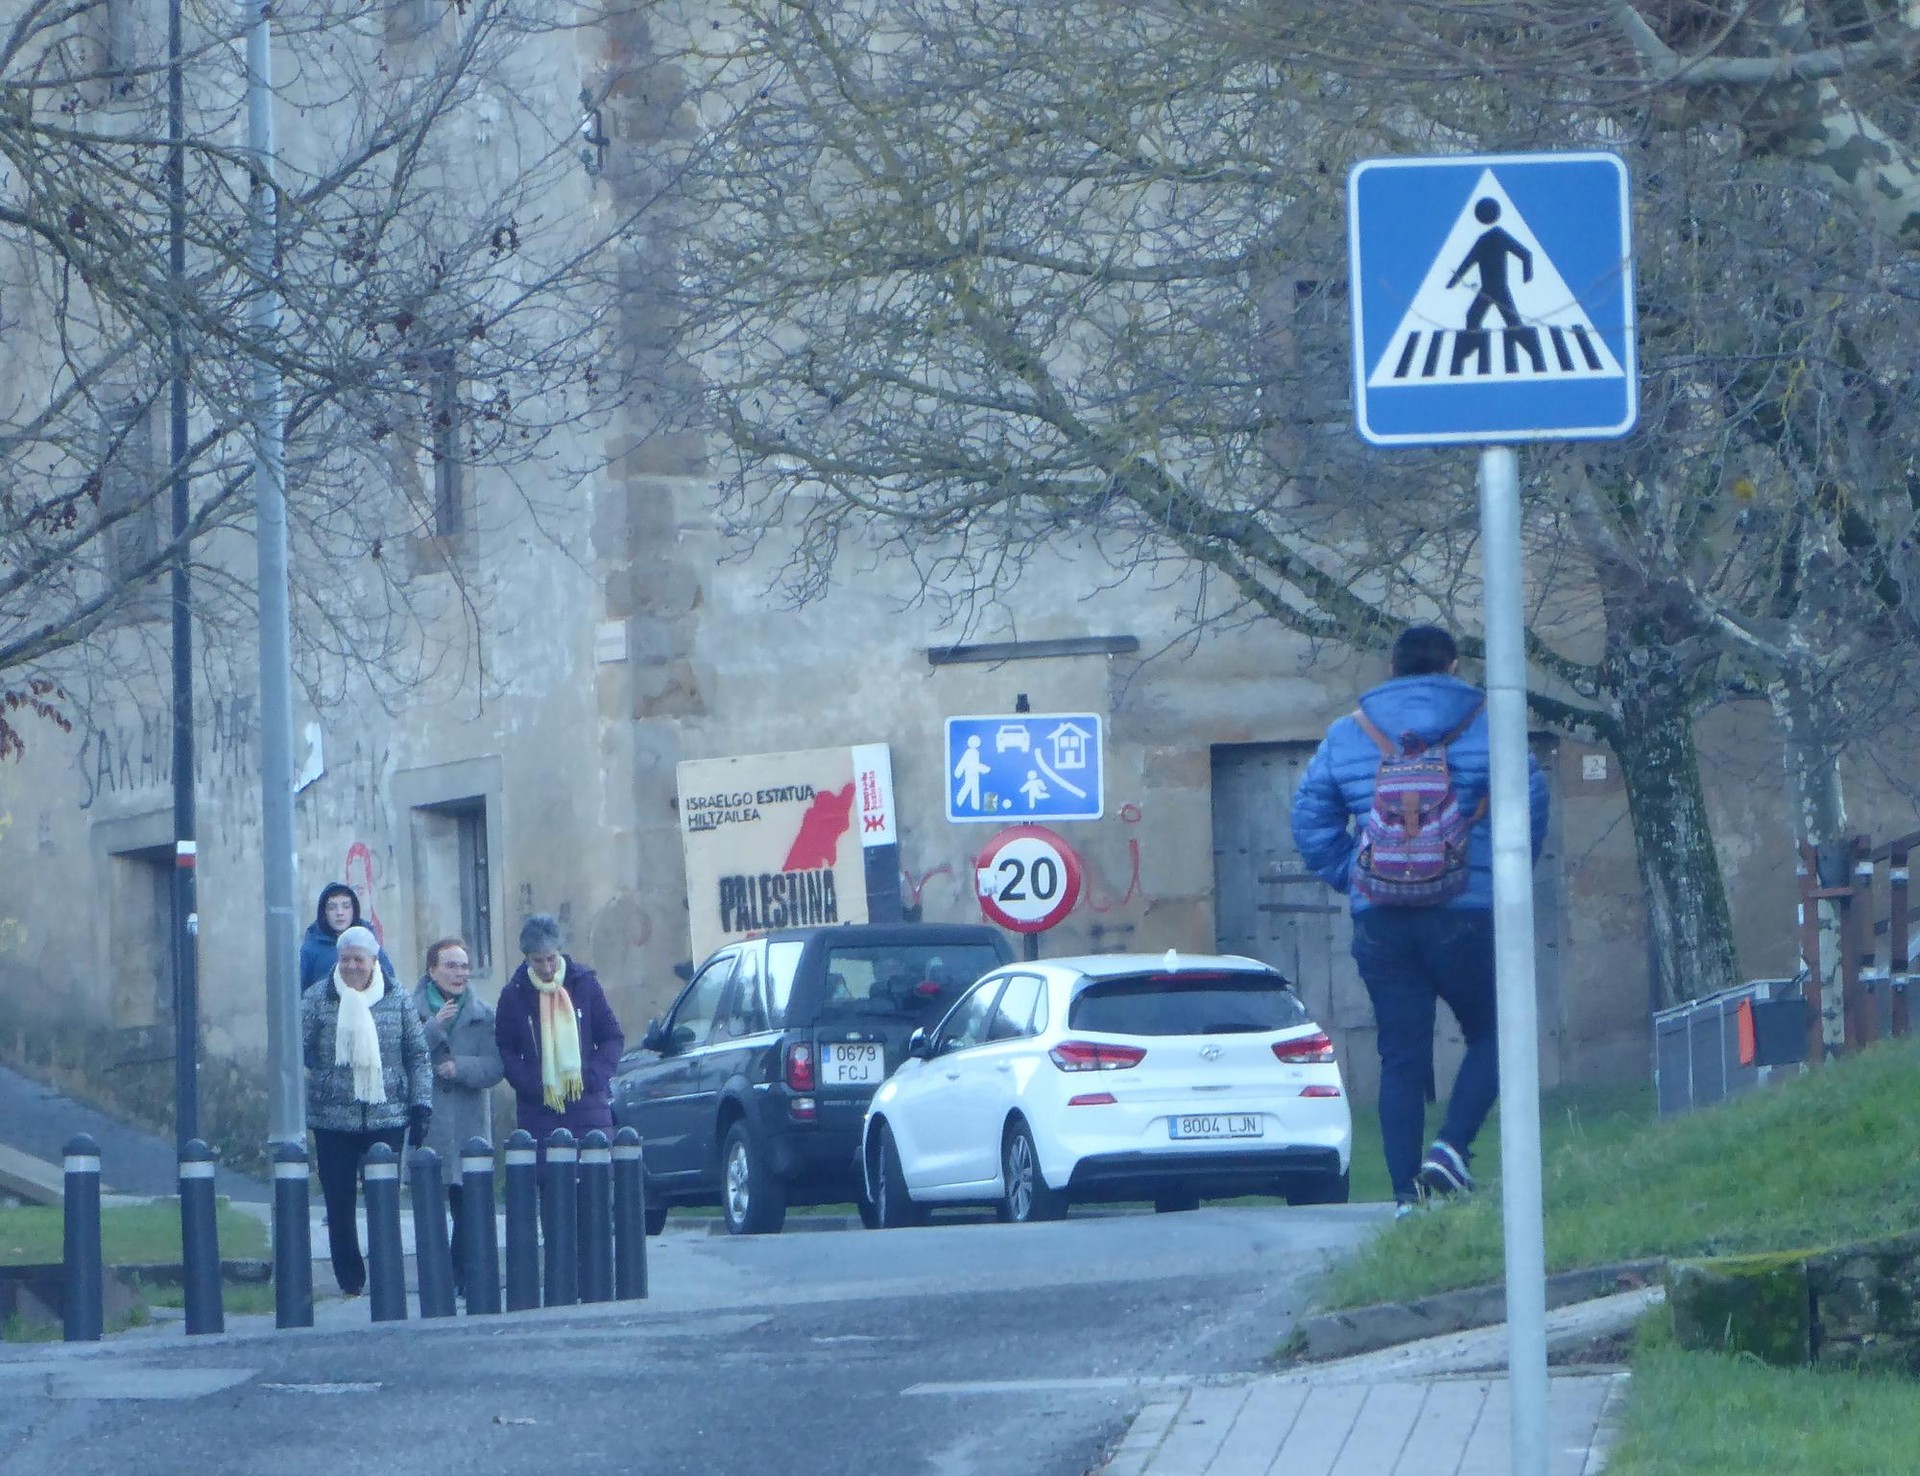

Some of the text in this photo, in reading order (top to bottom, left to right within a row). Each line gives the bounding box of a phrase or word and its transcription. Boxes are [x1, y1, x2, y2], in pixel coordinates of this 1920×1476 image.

[686, 785, 815, 811] ISRAELGO ESTATUA
[688, 808, 761, 828] HILTZAILEA
[998, 857, 1058, 902] 20
[719, 869, 838, 933] PALESTINA
[837, 1045, 876, 1062] 0679
[838, 1065, 868, 1081] FCJ
[1182, 1116, 1256, 1134] 8004 LJN
